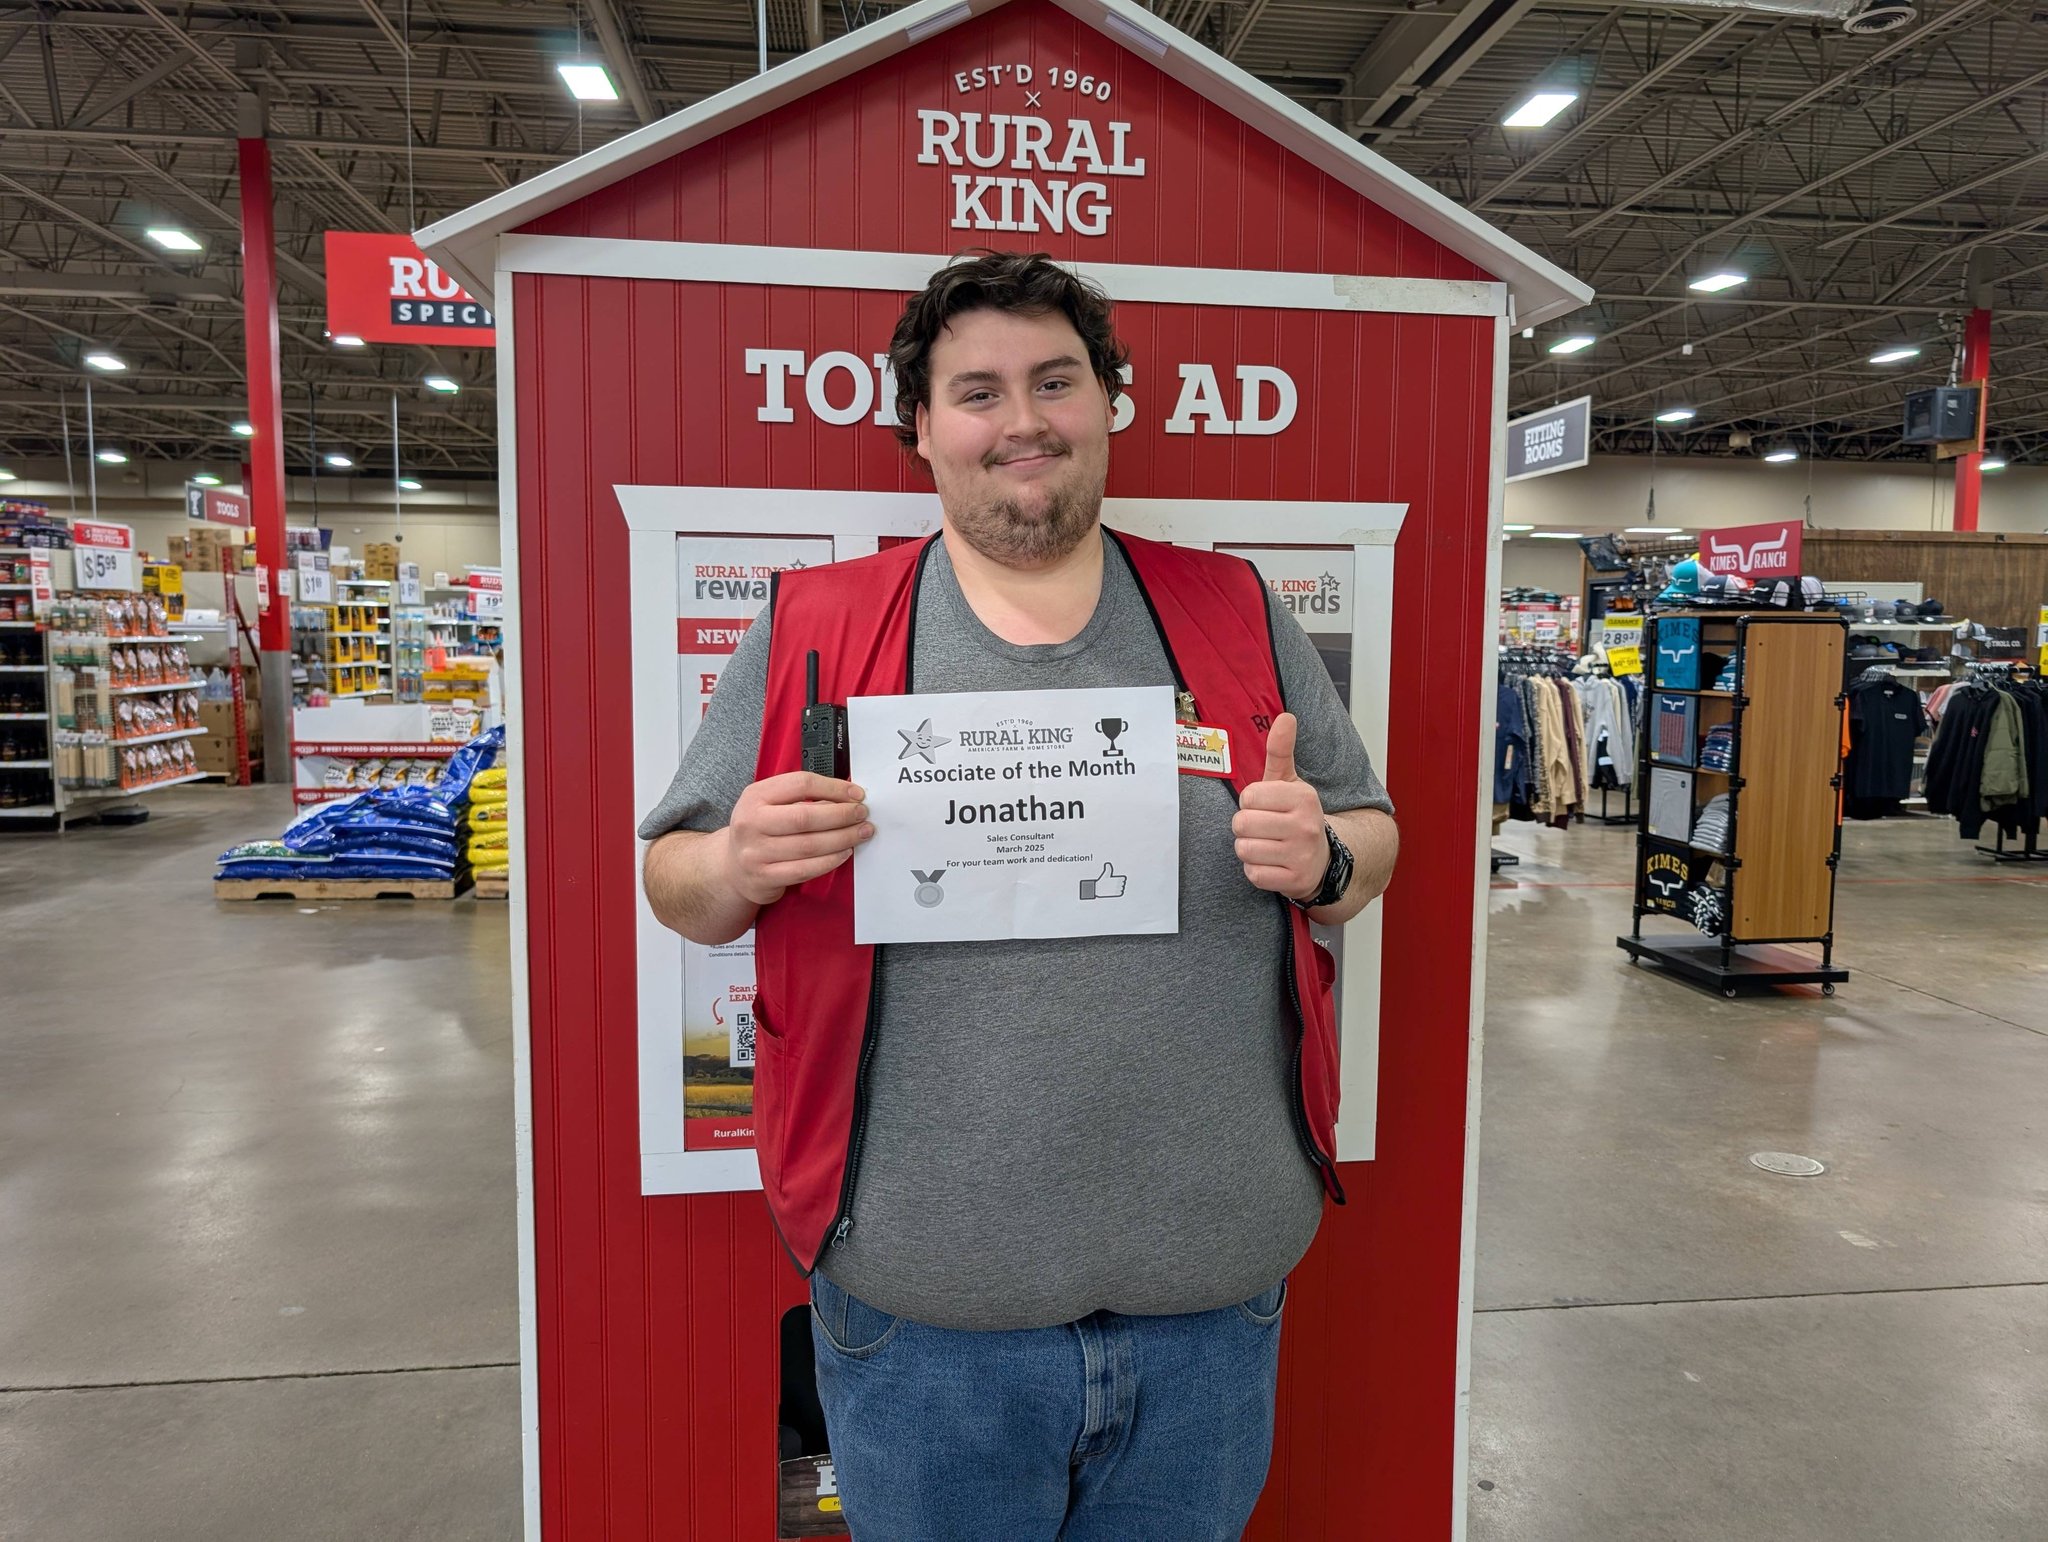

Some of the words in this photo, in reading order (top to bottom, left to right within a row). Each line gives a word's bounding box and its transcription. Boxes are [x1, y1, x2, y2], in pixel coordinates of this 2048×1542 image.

[954, 63, 1033, 93] EST'D
[1048, 66, 1112, 101] 1960
[917, 109, 1146, 177] RURAL
[951, 174, 1112, 235] KING
[1165, 363, 1298, 436] AD
[1524, 418, 1566, 447] FITTING
[1524, 438, 1563, 465] ROOMS
[216, 500, 240, 518] TOOLS
[1709, 555, 1737, 571] KIMES
[1754, 551, 1787, 569] RANCH
[695, 565, 747, 578] RURAL
[1281, 580, 1317, 592] KING
[996, 718, 1015, 727] EST'D
[1017, 718, 1034, 726] 1960
[959, 729, 1024, 746] RURAL
[1028, 728, 1073, 744] KING
[1177, 752, 1221, 765] NATHAN
[897, 762, 996, 784] Associate
[1002, 761, 1024, 780] of
[1028, 760, 1062, 778] the
[1069, 758, 1136, 778] Month
[944, 794, 1085, 825] Jonathan
[986, 833, 1009, 843] Sales
[1010, 832, 1055, 842] Consultant
[996, 844, 1023, 854] March
[1024, 843, 1045, 852] 2025
[946, 859, 960, 868] For
[962, 859, 981, 869] your
[983, 857, 1005, 866] team
[1007, 856, 1028, 865] work
[1029, 855, 1045, 864] and
[1047, 853, 1094, 864] dedication!
[1646, 853, 1689, 881] KIMES
[729, 984, 751, 993] Scan
